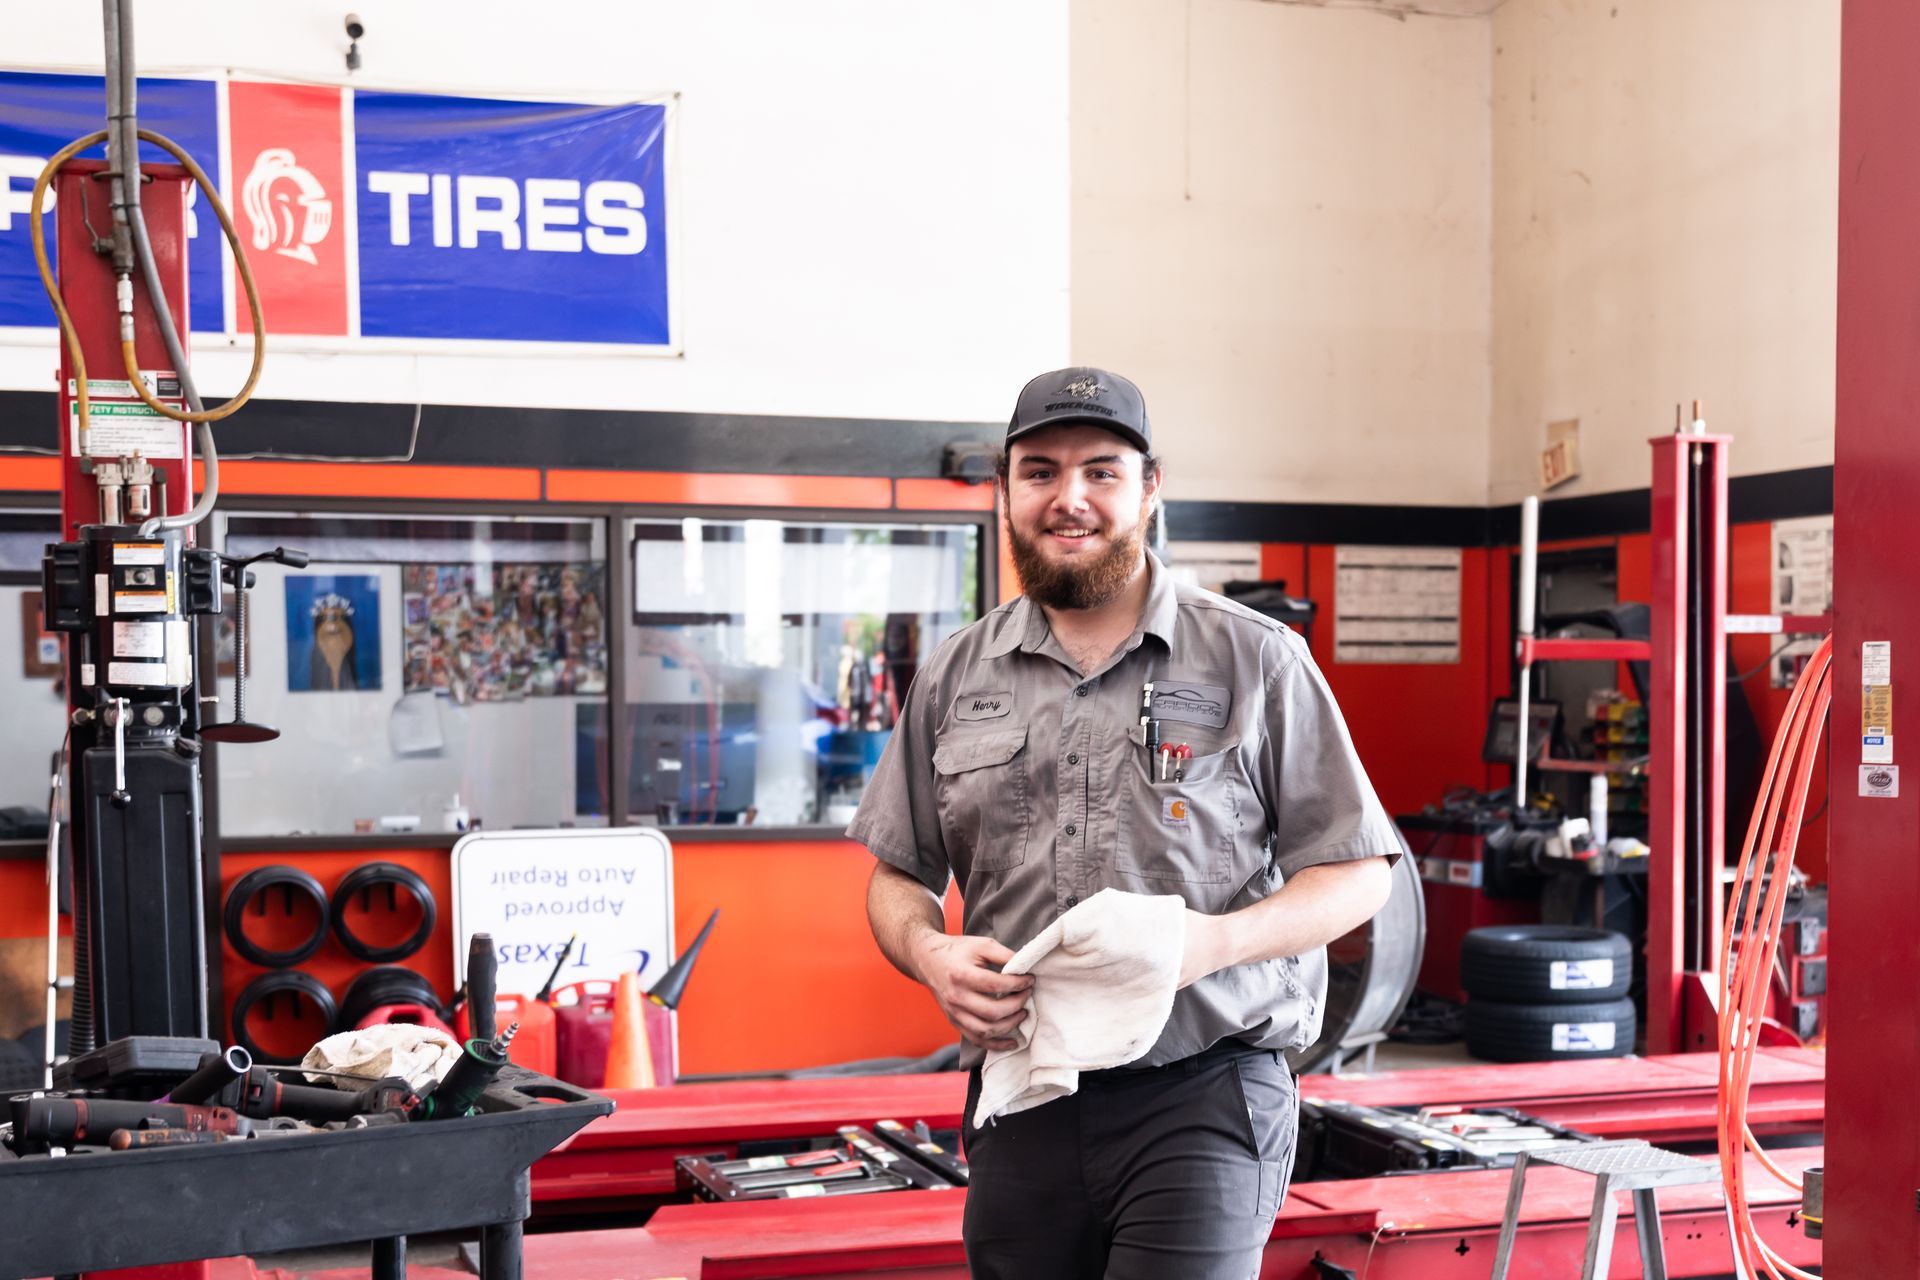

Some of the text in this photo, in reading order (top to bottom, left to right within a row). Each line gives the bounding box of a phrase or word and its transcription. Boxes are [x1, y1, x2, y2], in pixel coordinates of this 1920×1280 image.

[368, 171, 648, 255] TIRES
[972, 700, 1001, 711] Henry
[491, 866, 636, 888] Auto Repair
[505, 896, 625, 921] Approved
[498, 943, 590, 967] Texas
